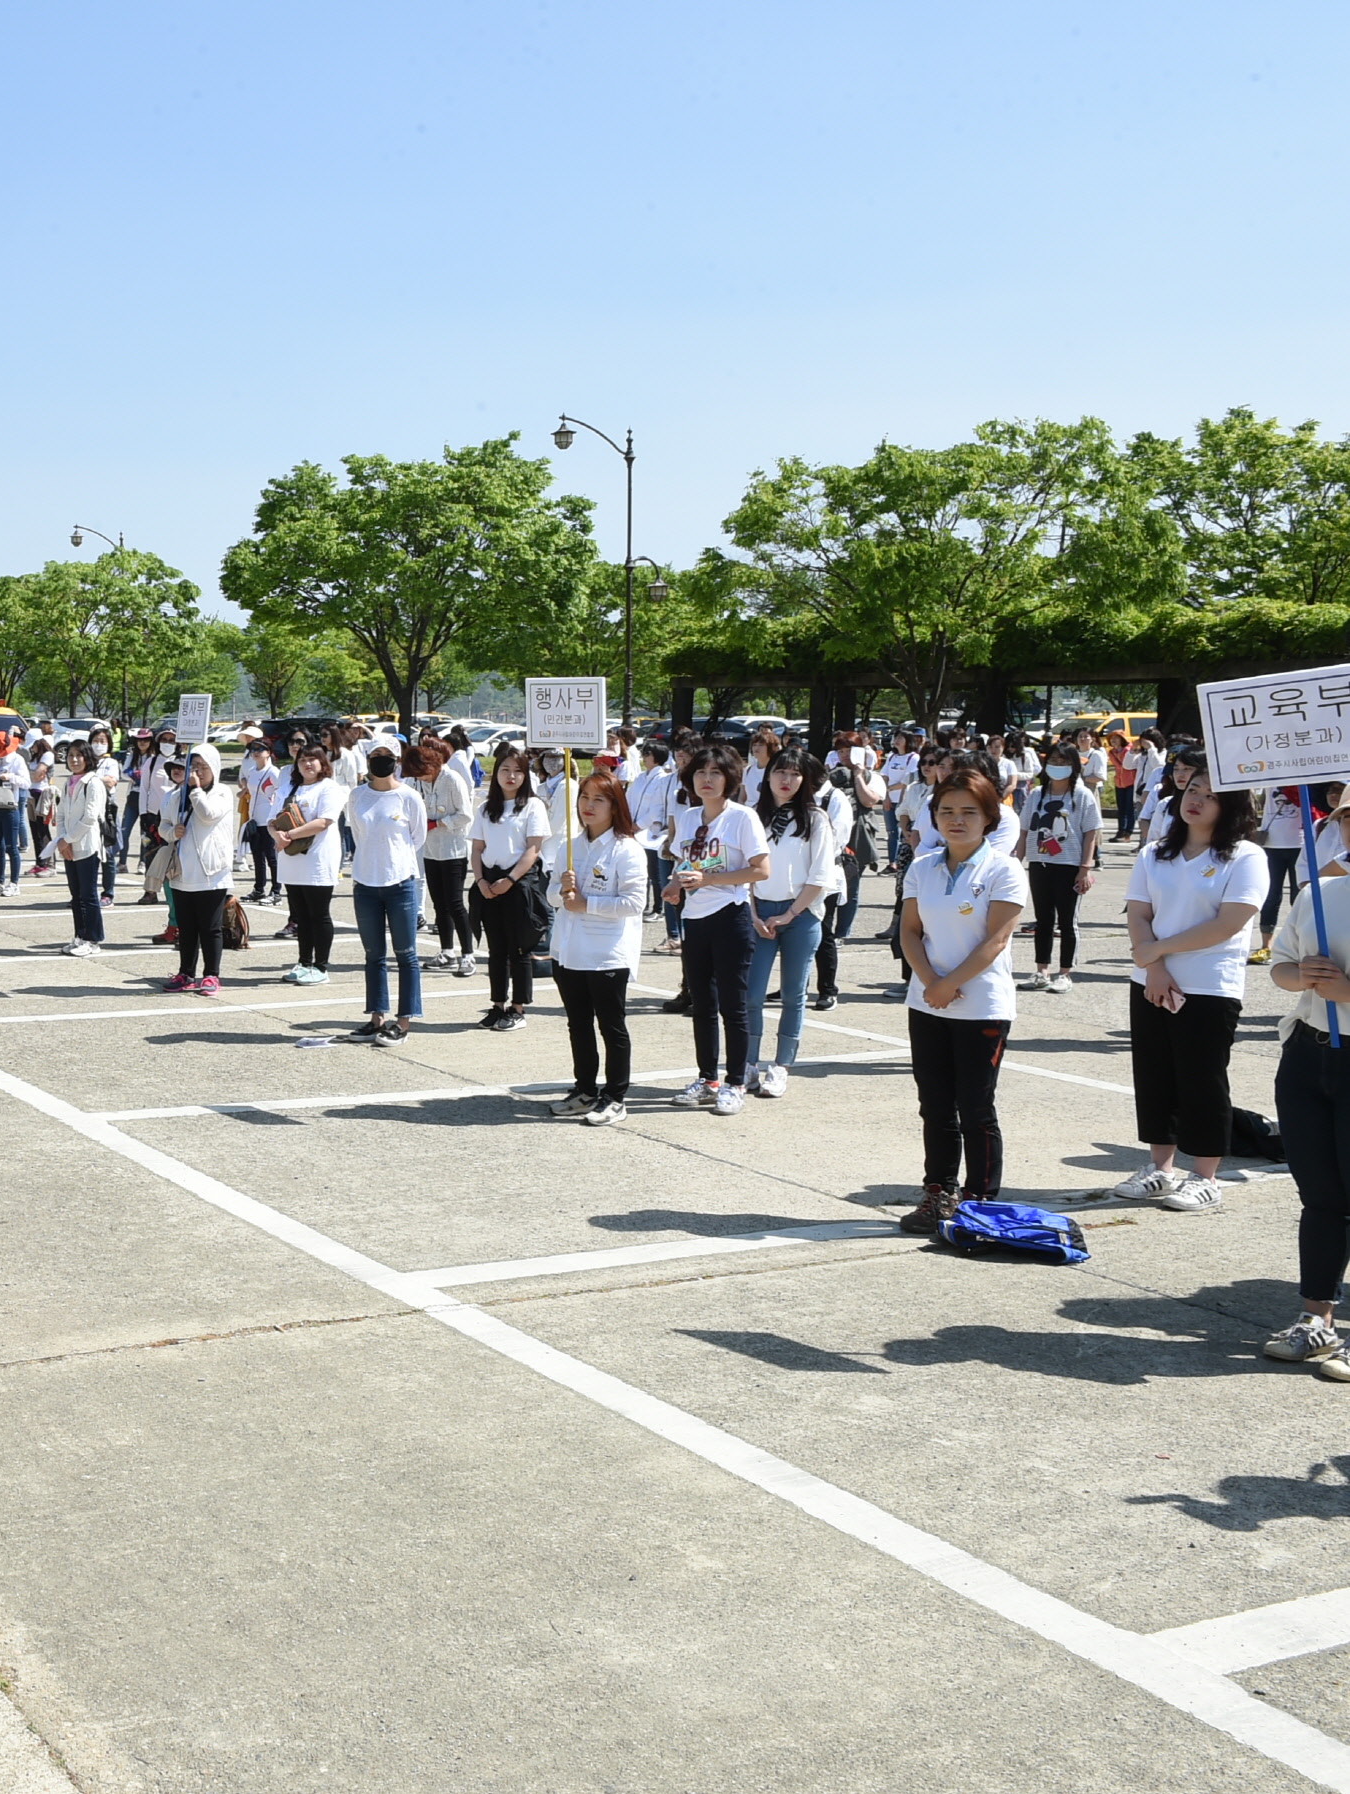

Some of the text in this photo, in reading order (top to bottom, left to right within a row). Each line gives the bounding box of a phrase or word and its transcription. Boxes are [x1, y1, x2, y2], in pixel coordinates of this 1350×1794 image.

[182, 700, 205, 716] 행사부
[535, 688, 594, 710] 행사부
[1223, 681, 1350, 728] 교육부
[543, 714, 586, 725] (민간분과)
[1246, 726, 1343, 752] (가정분과)
[1266, 753, 1350, 770] 경주시사립어린이집연
